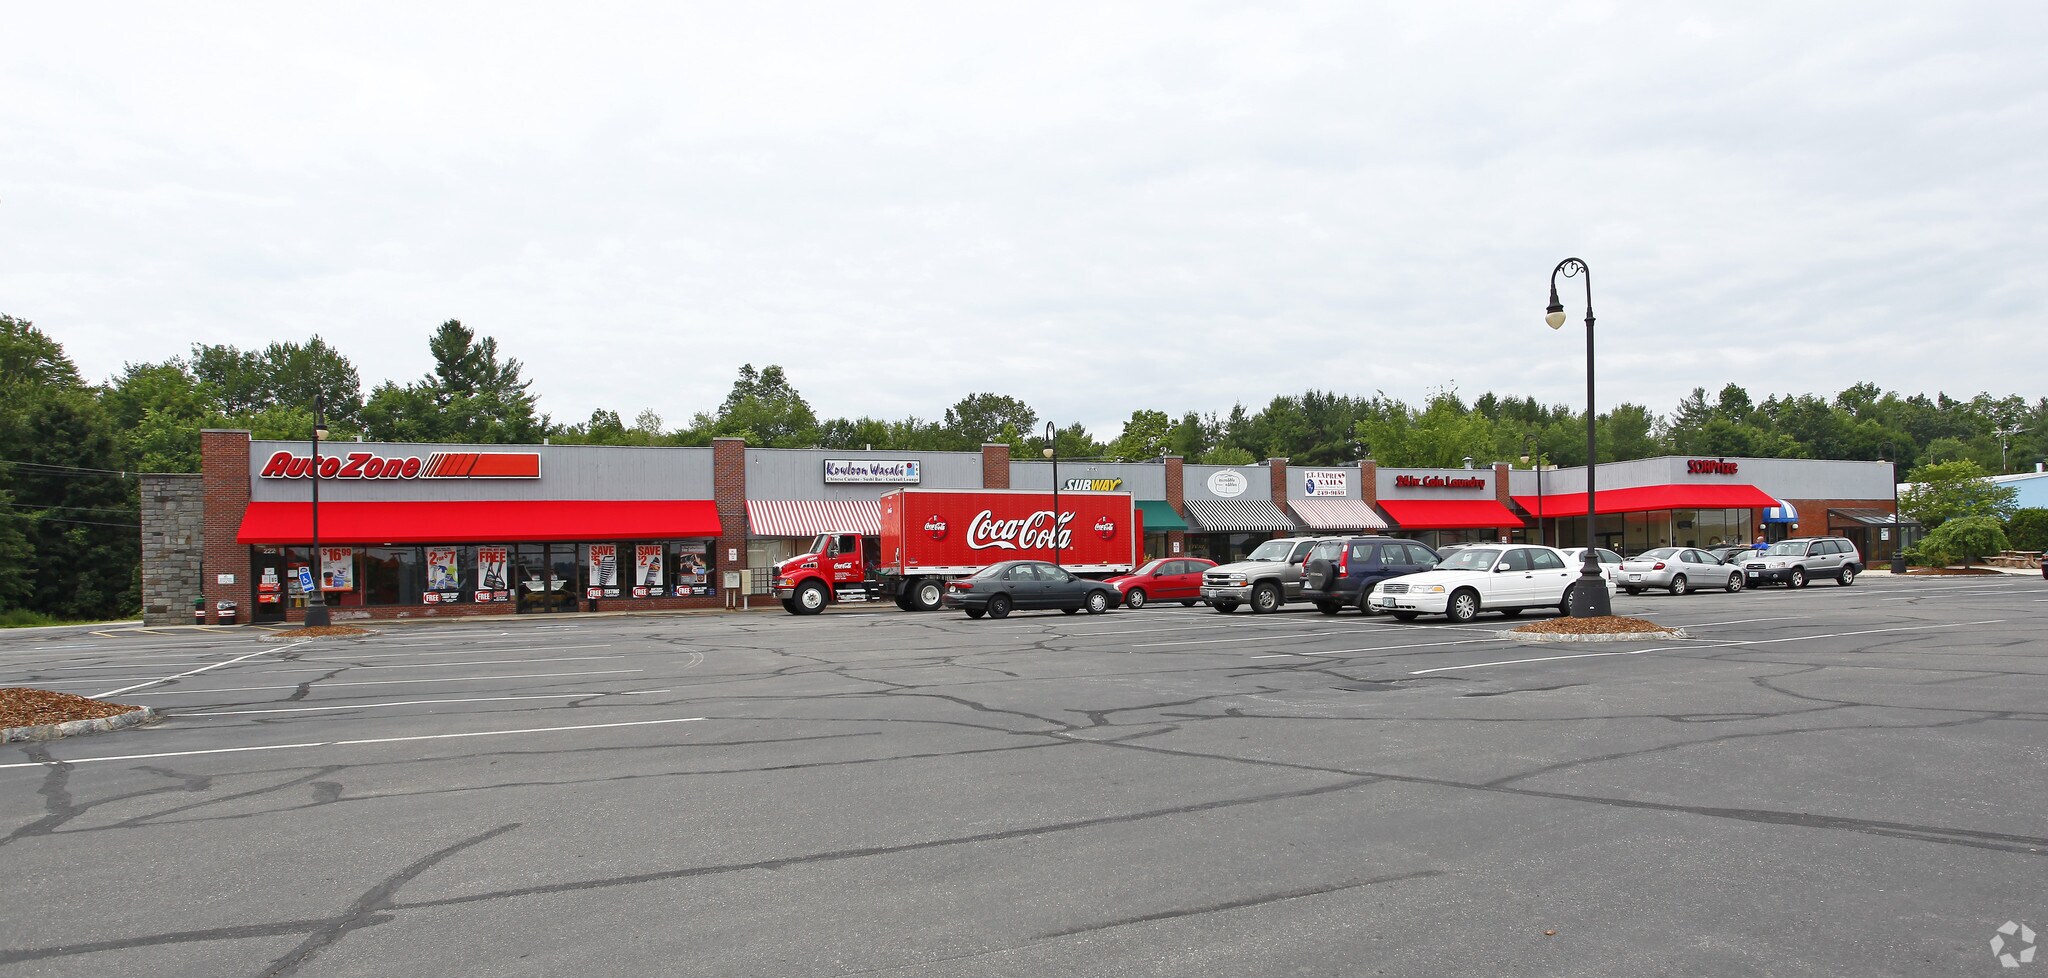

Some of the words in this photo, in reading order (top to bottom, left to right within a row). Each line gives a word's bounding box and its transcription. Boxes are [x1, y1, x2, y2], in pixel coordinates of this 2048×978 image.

[827, 462, 868, 476] Kowloon
[870, 463, 904, 476] Wasabi
[1063, 477, 1122, 491] SUBWAY
[1423, 475, 1445, 487] Coin
[1446, 475, 1486, 490] Laundry
[966, 509, 1076, 550] Coca-Cola
[591, 545, 615, 555] SAVE
[638, 545, 661, 555] SAVE
[429, 551, 438, 565] 2
[479, 551, 506, 563] FREE
[589, 589, 602, 597] FREE
[635, 588, 647, 596] FREE
[678, 587, 691, 595] FREE
[426, 594, 439, 602] FREE
[477, 593, 491, 601] FREE
